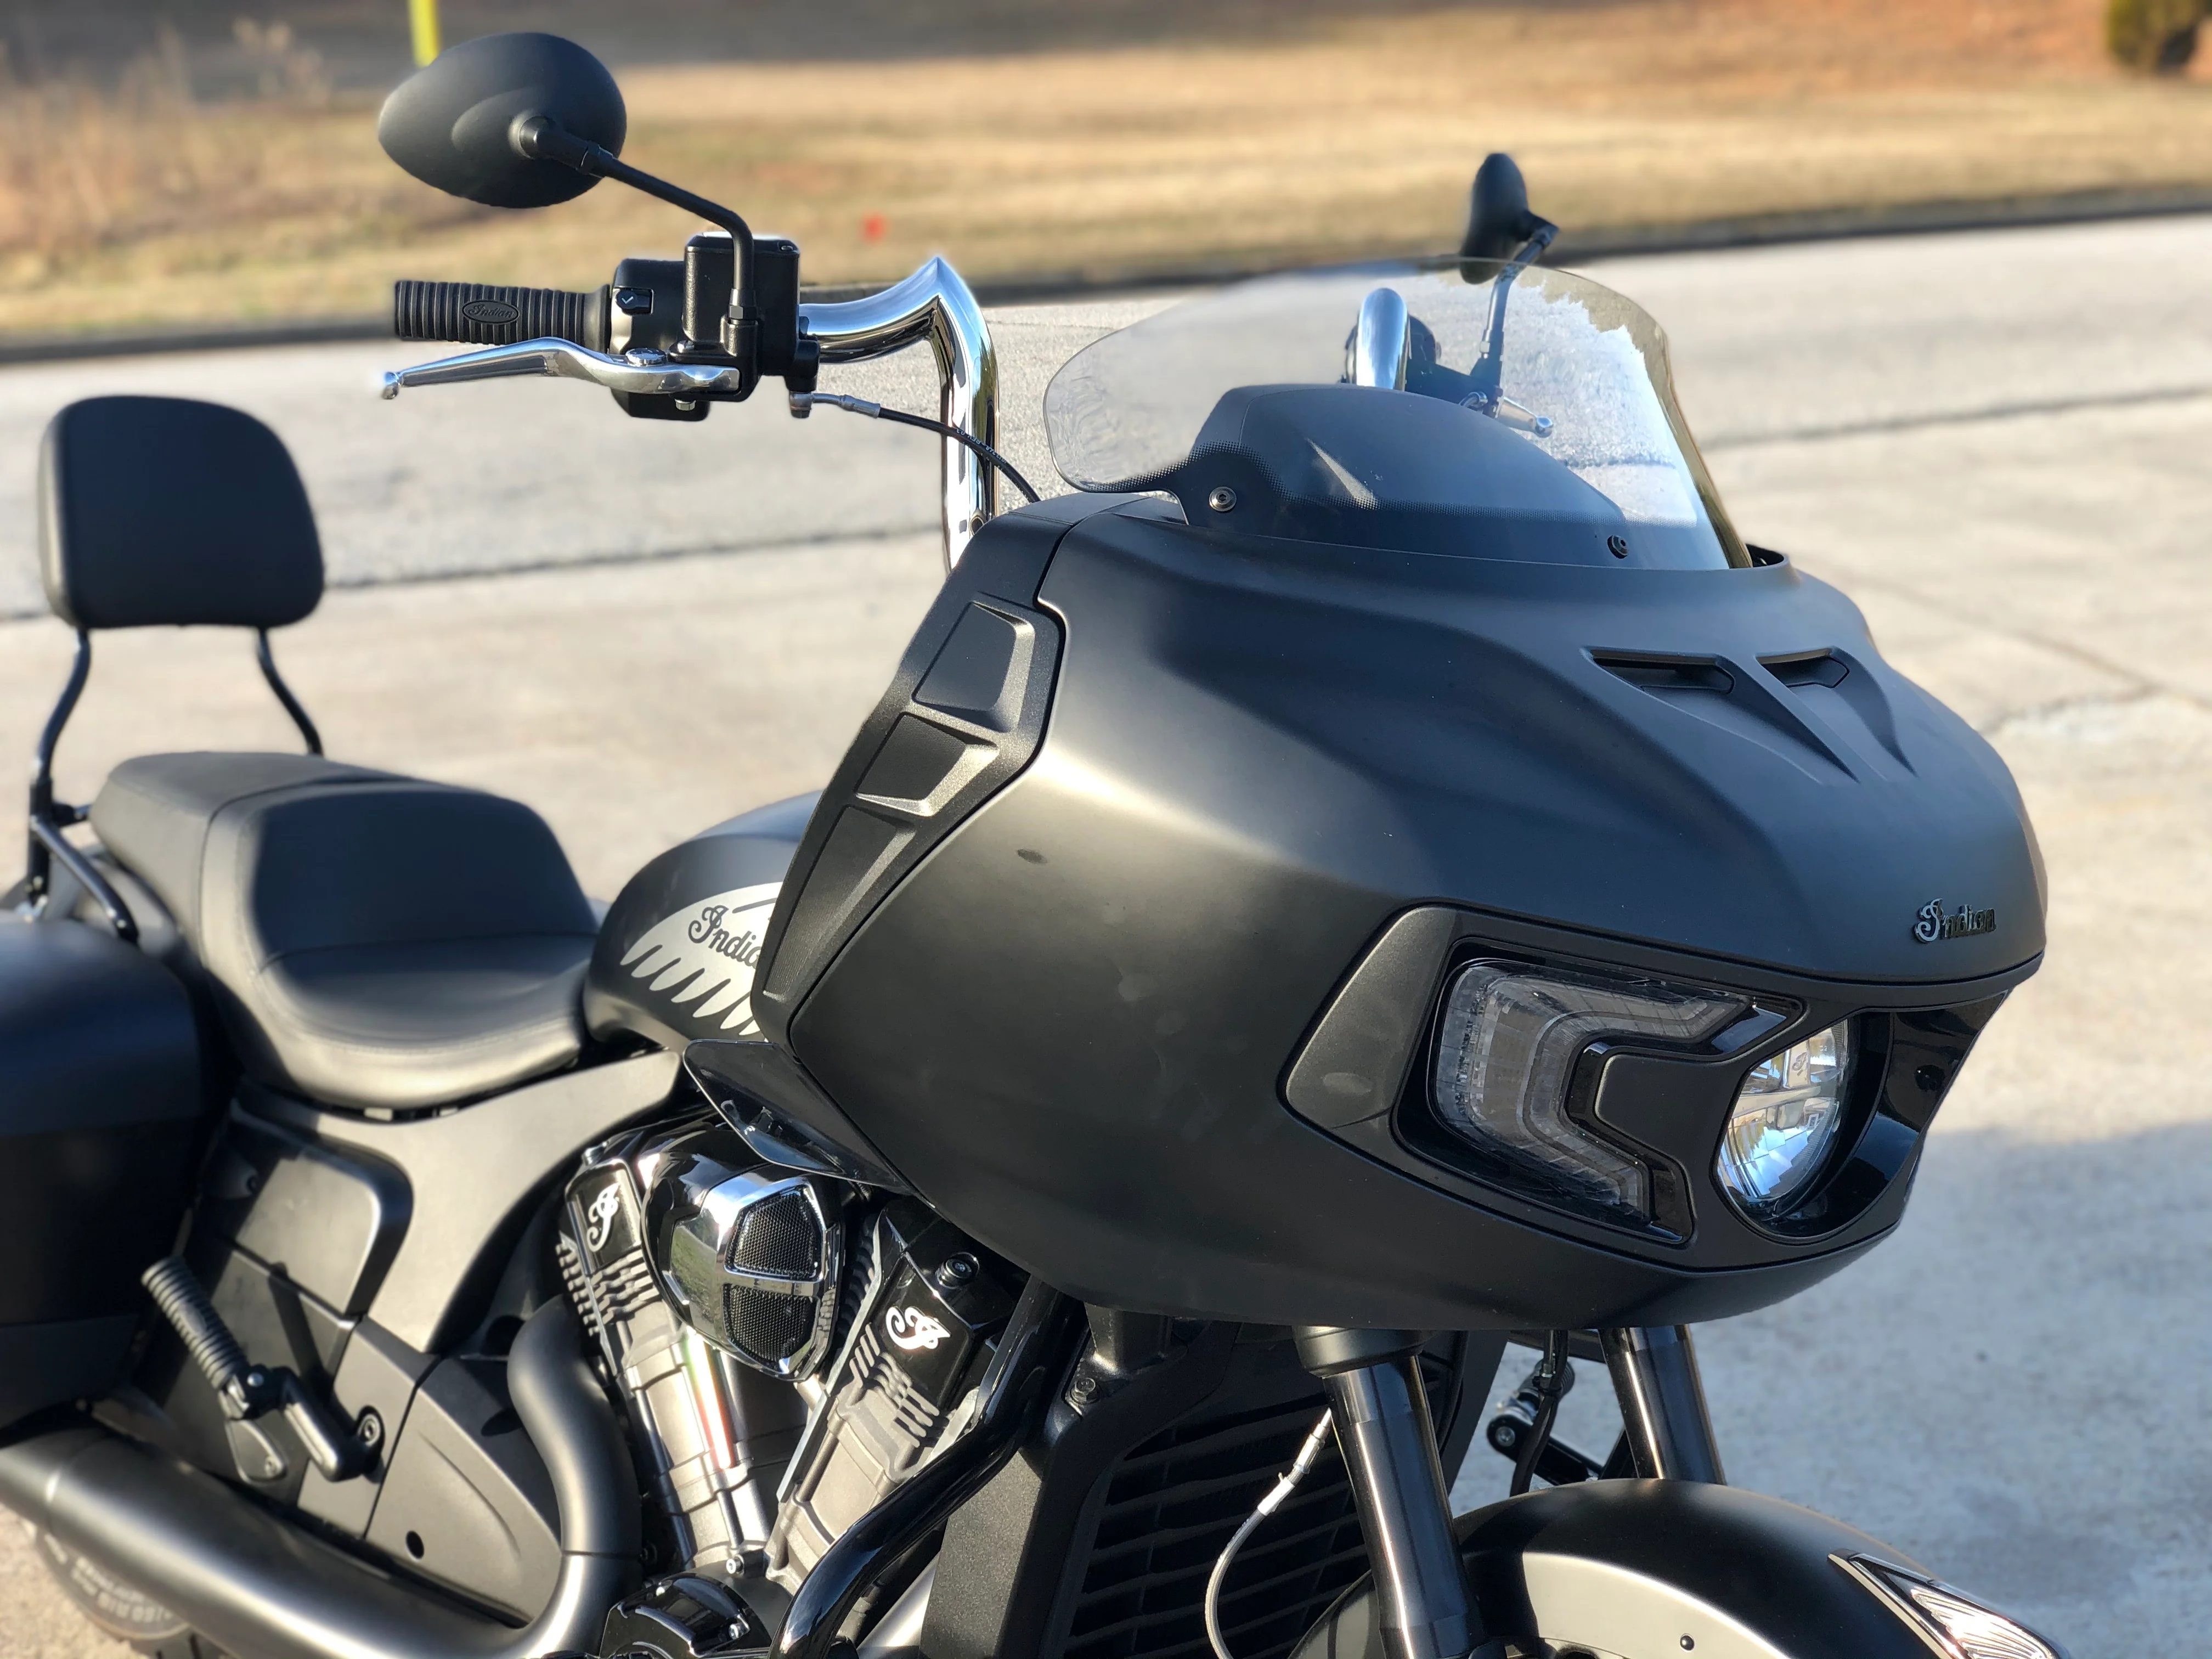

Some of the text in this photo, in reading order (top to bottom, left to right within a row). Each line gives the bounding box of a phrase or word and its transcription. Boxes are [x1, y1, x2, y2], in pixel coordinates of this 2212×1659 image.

[468, 304, 514, 318] Indian
[688, 905, 762, 969] India
[1914, 898, 1997, 943] Indian
